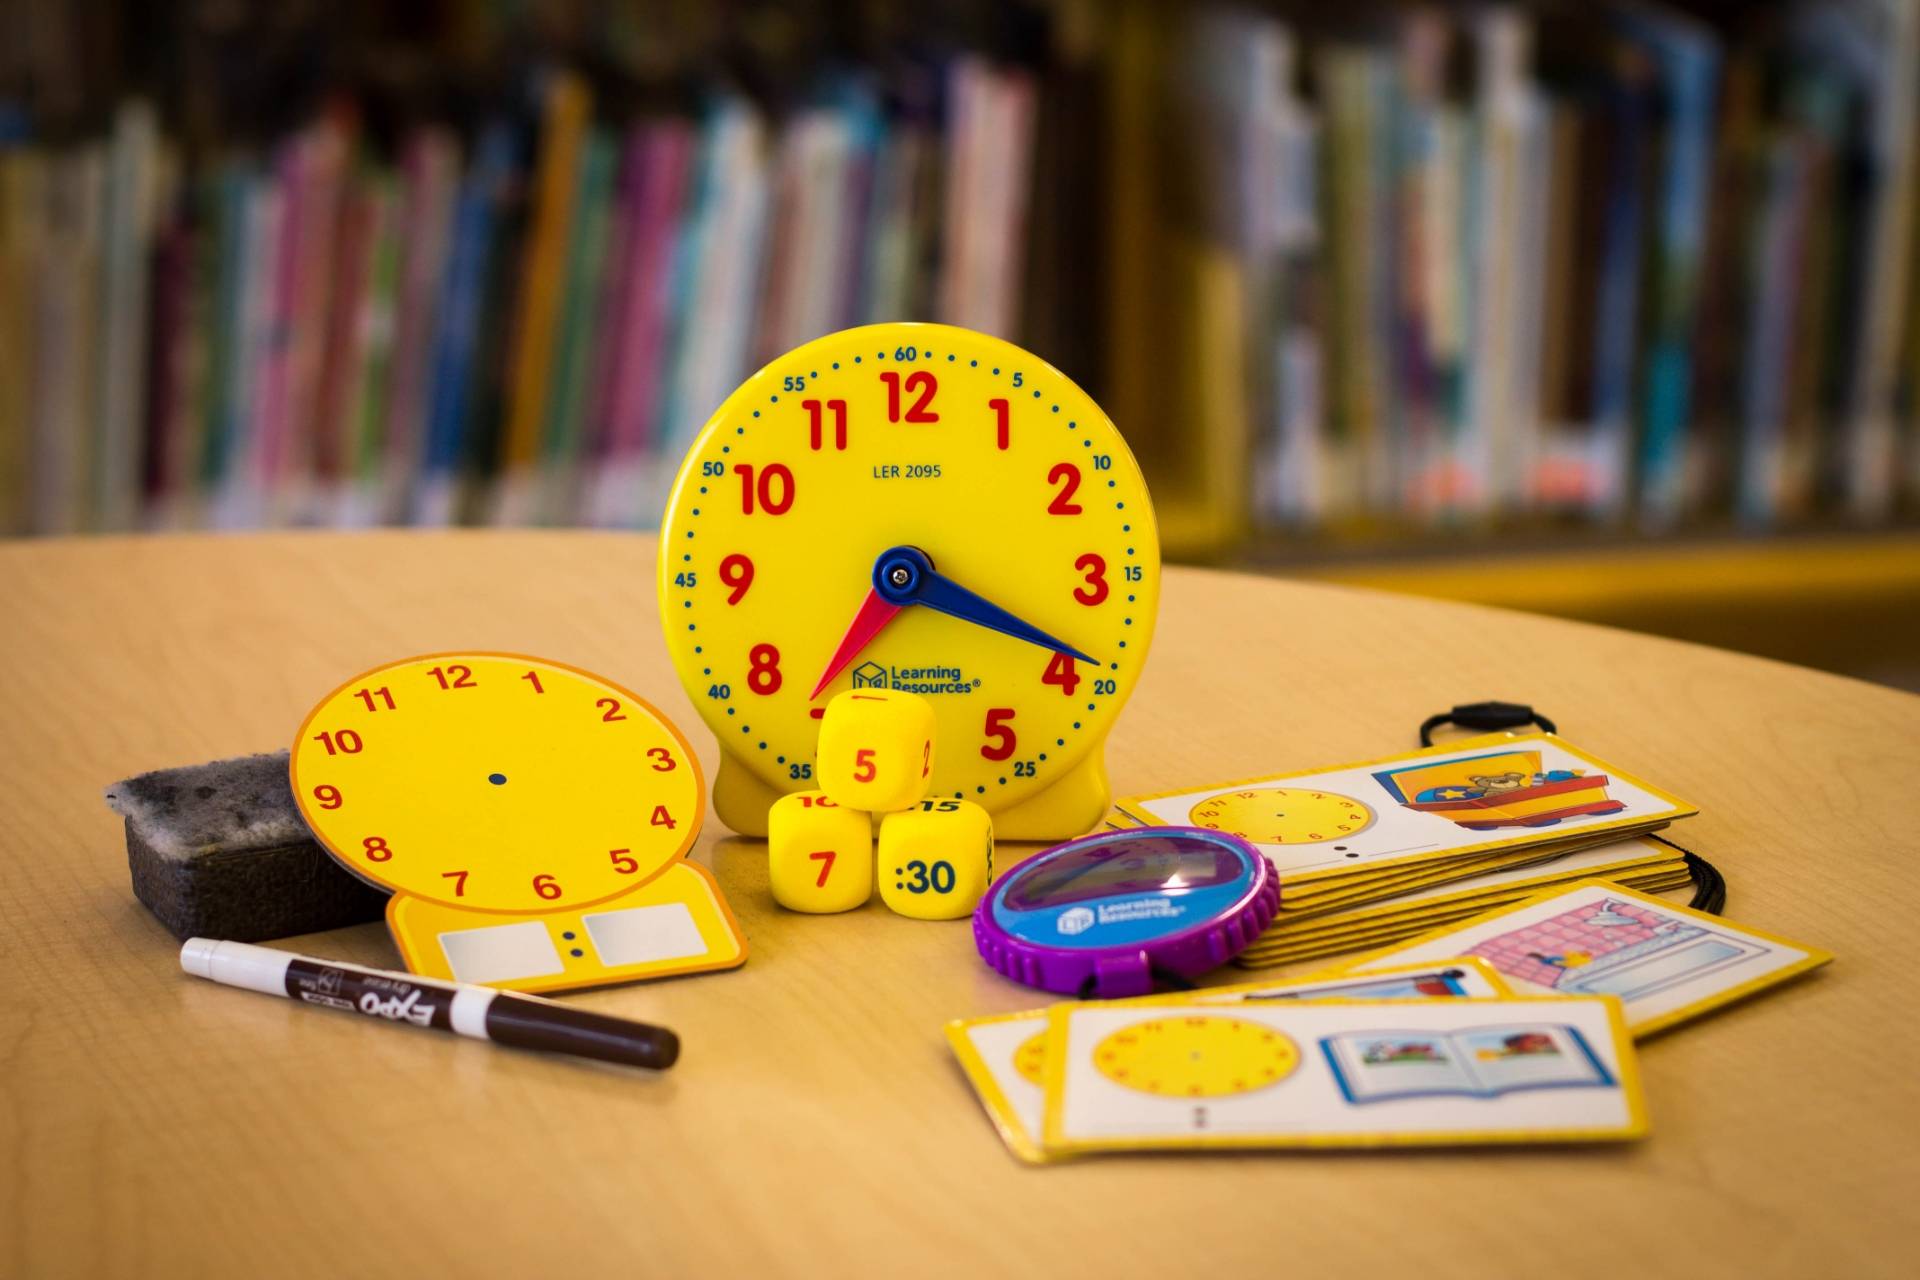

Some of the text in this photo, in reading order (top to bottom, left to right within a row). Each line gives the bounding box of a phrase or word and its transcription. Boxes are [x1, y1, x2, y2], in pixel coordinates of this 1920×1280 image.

[894, 346, 917, 362] 60
[783, 376, 806, 392] 55
[1012, 372, 1023, 387] 5
[880, 371, 940, 423] 12
[802, 400, 847, 451] 11
[989, 399, 1010, 451] 1
[702, 461, 725, 477] 50
[873, 464, 941, 478] LER 2095
[1093, 455, 1112, 471] 10
[734, 463, 796, 516] 10
[1047, 463, 1083, 516] 2
[674, 572, 697, 588] 45
[719, 554, 755, 606] 9
[1073, 553, 1110, 607] 3
[1125, 566, 1142, 582] 15
[427, 665, 478, 690] 12
[521, 671, 545, 694] 1
[747, 643, 783, 696] 8
[891, 665, 961, 682] Learning
[1041, 651, 1081, 696] 4
[353, 686, 397, 712] 11
[707, 684, 731, 700] 40
[1094, 679, 1117, 695] 20
[595, 698, 627, 722] 2
[313, 729, 364, 756] 10
[980, 708, 1018, 762] 5
[646, 747, 677, 772] 3
[789, 763, 812, 780] 35
[853, 749, 877, 783] 5
[1013, 761, 1037, 778] 25
[313, 784, 343, 810] 9
[650, 805, 677, 830] 4
[362, 836, 393, 862] 8
[609, 848, 640, 875] 5
[809, 851, 837, 888] 7
[895, 860, 956, 894] :30
[441, 870, 470, 897] 7
[532, 874, 563, 900] 6
